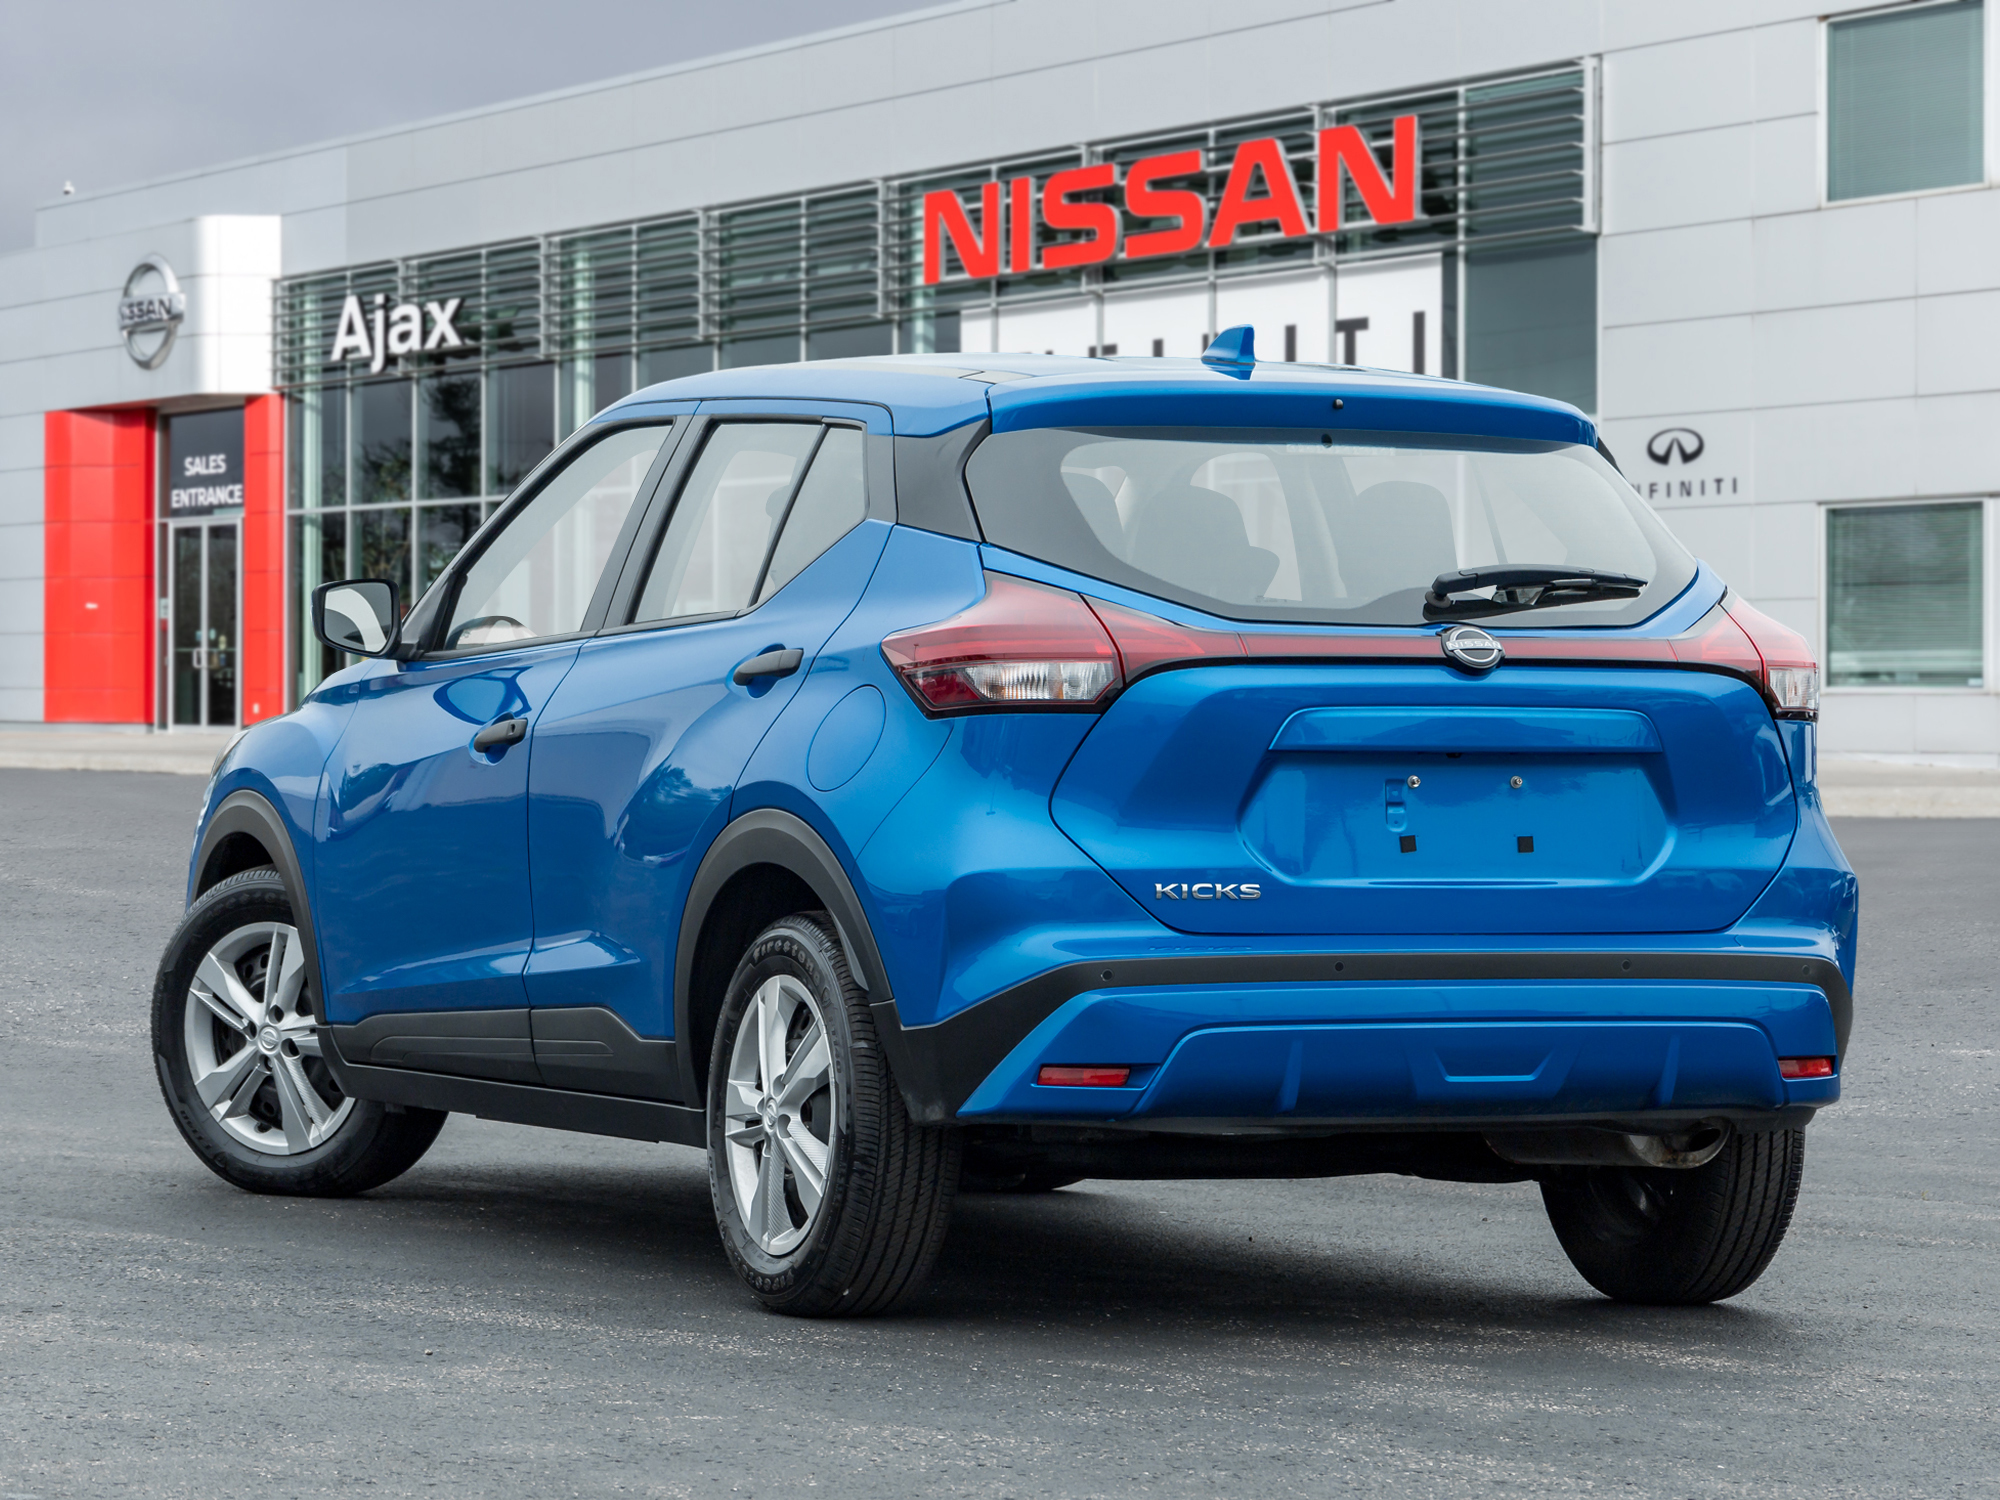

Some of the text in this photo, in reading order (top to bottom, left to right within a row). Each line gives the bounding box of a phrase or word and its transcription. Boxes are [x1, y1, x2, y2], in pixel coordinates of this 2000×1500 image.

[923, 114, 1418, 285] NISSAN
[121, 298, 173, 322] SSAN
[331, 293, 462, 374] Ajax
[184, 454, 227, 476] SALES
[172, 483, 243, 508] ENTRANCE
[1630, 477, 1737, 499] FINITI
[1448, 639, 1501, 650] NISSAN
[1155, 883, 1261, 900] KICKS
